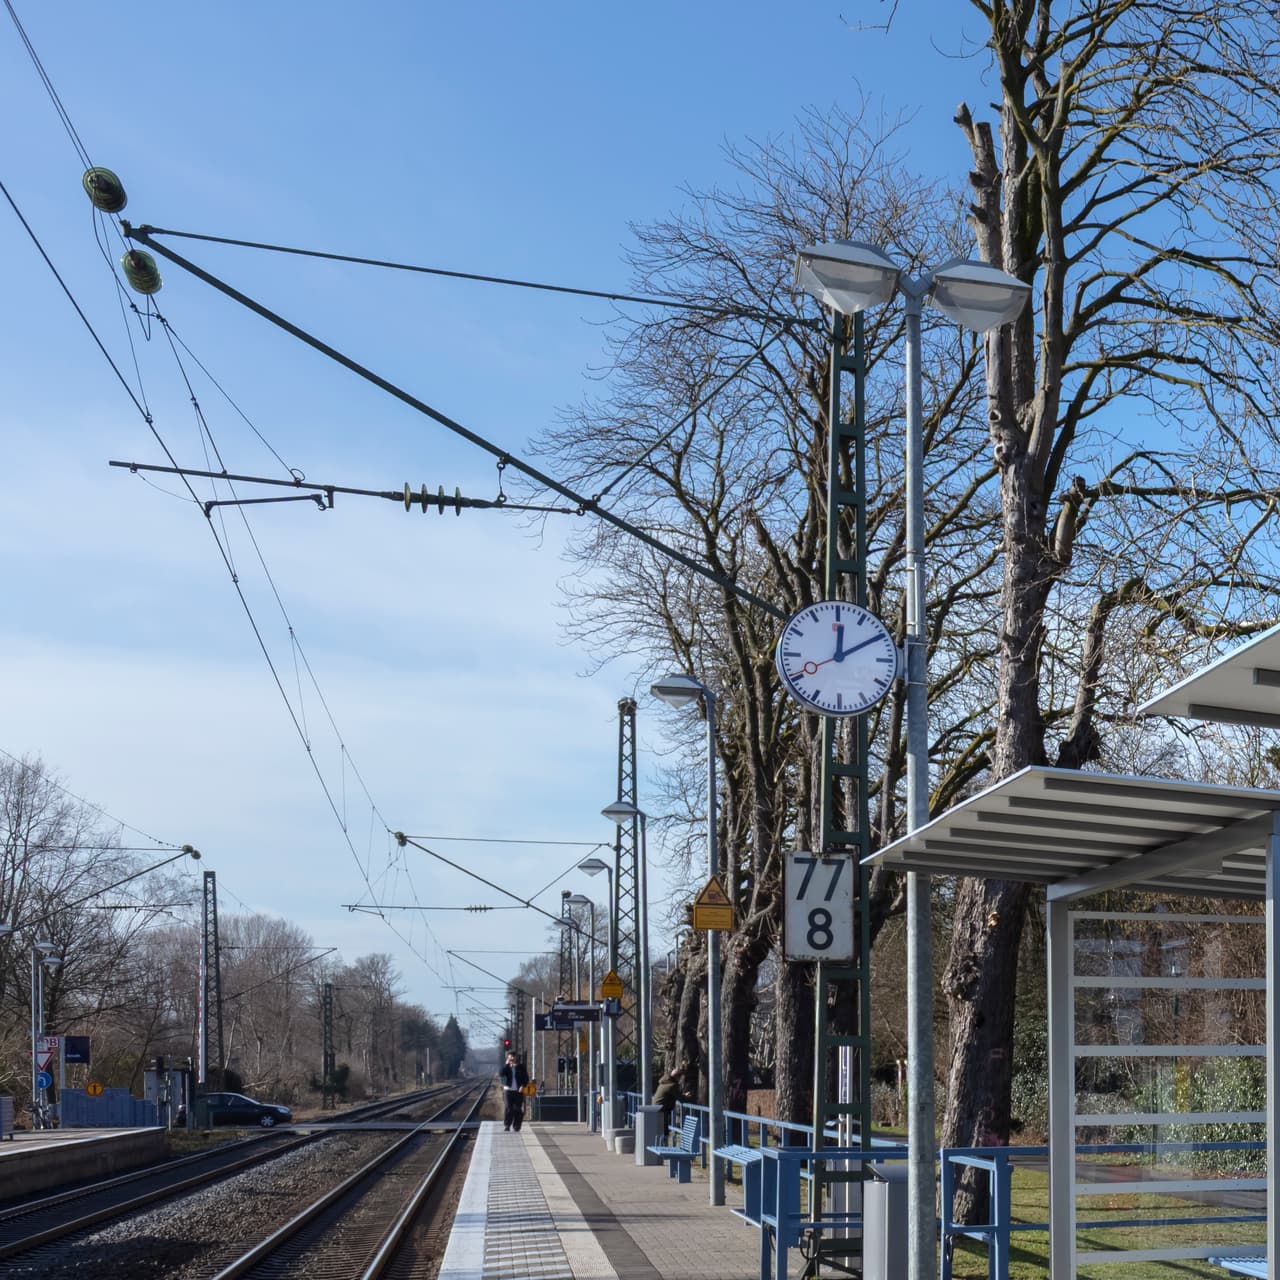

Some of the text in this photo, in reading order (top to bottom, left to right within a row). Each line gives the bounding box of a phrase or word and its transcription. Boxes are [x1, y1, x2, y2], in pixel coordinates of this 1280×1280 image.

[794, 857, 845, 902] 77
[806, 907, 834, 951] 8
[544, 1016, 553, 1029] 1
